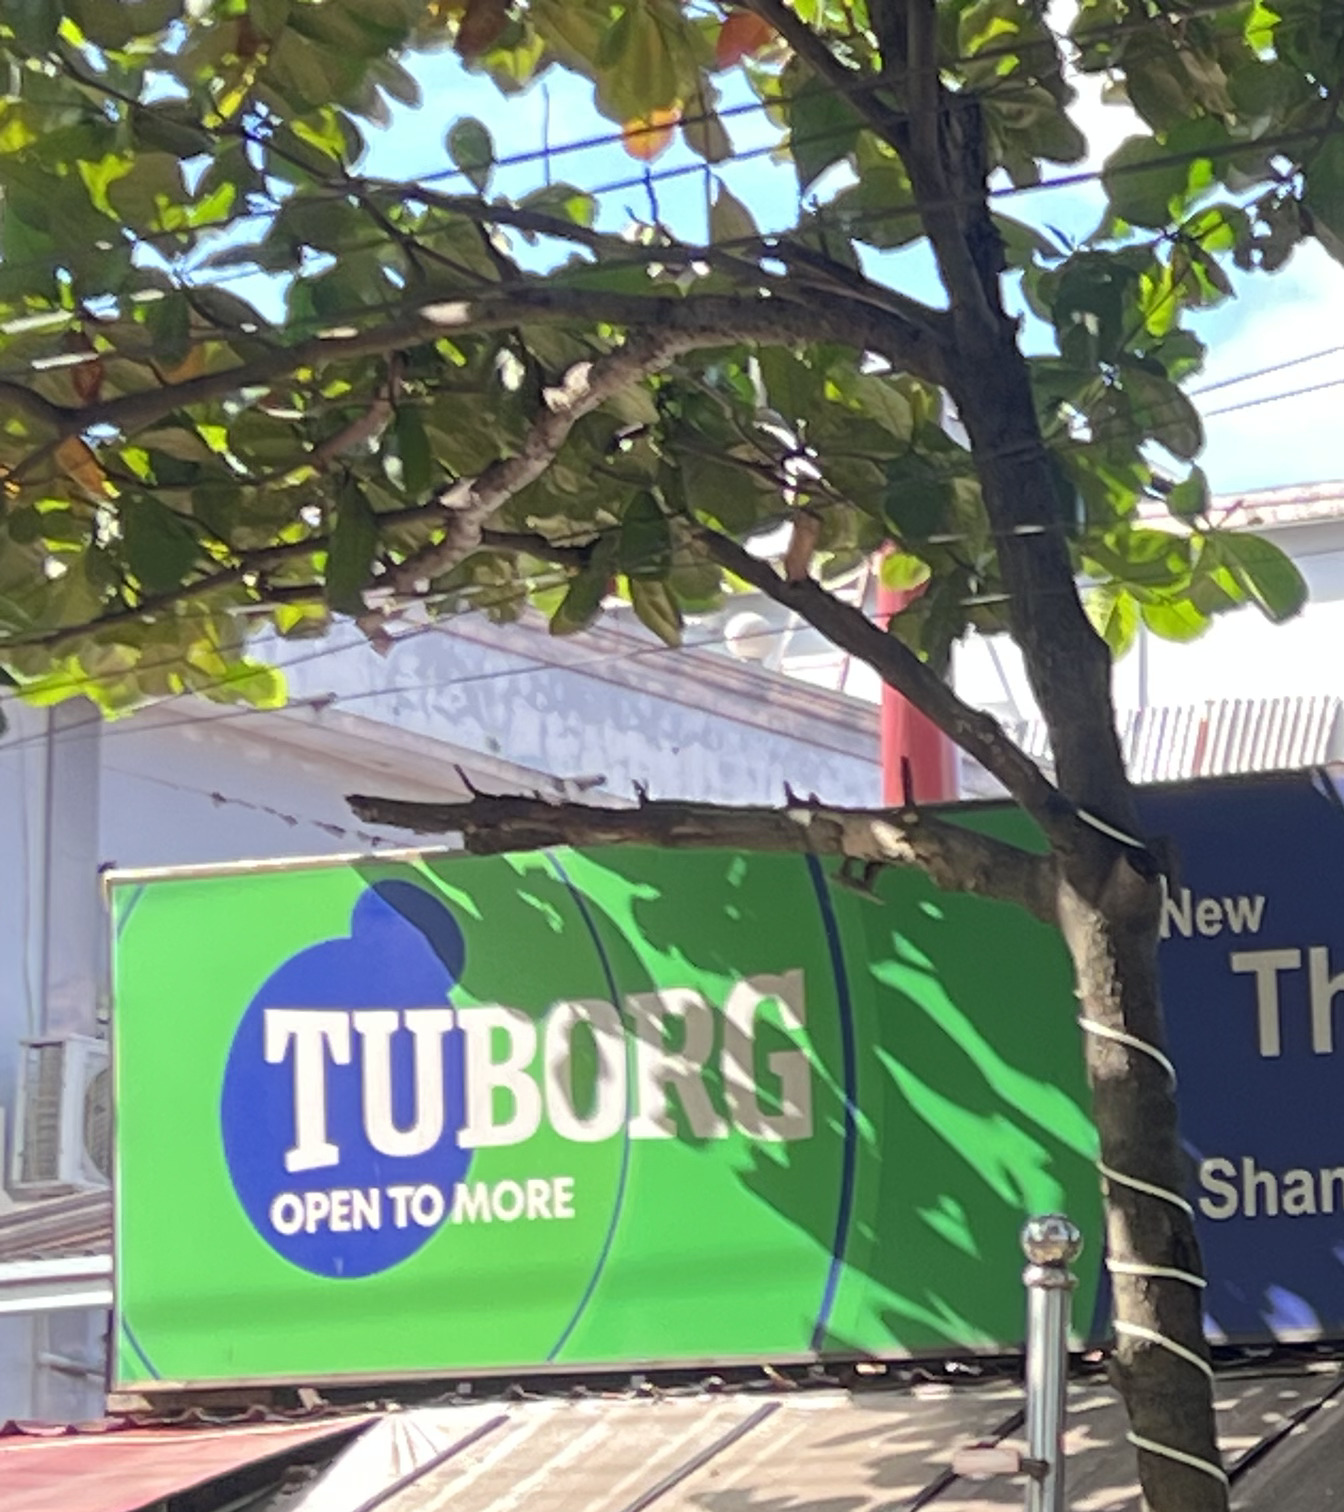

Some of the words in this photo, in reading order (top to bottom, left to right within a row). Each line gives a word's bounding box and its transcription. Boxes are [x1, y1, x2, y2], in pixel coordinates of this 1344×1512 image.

[1160, 886, 1266, 940] New
[264, 968, 815, 1173] TUBORG
[270, 1187, 380, 1238] OPEN
[387, 1182, 445, 1229] TO
[450, 1176, 576, 1225] MORE
